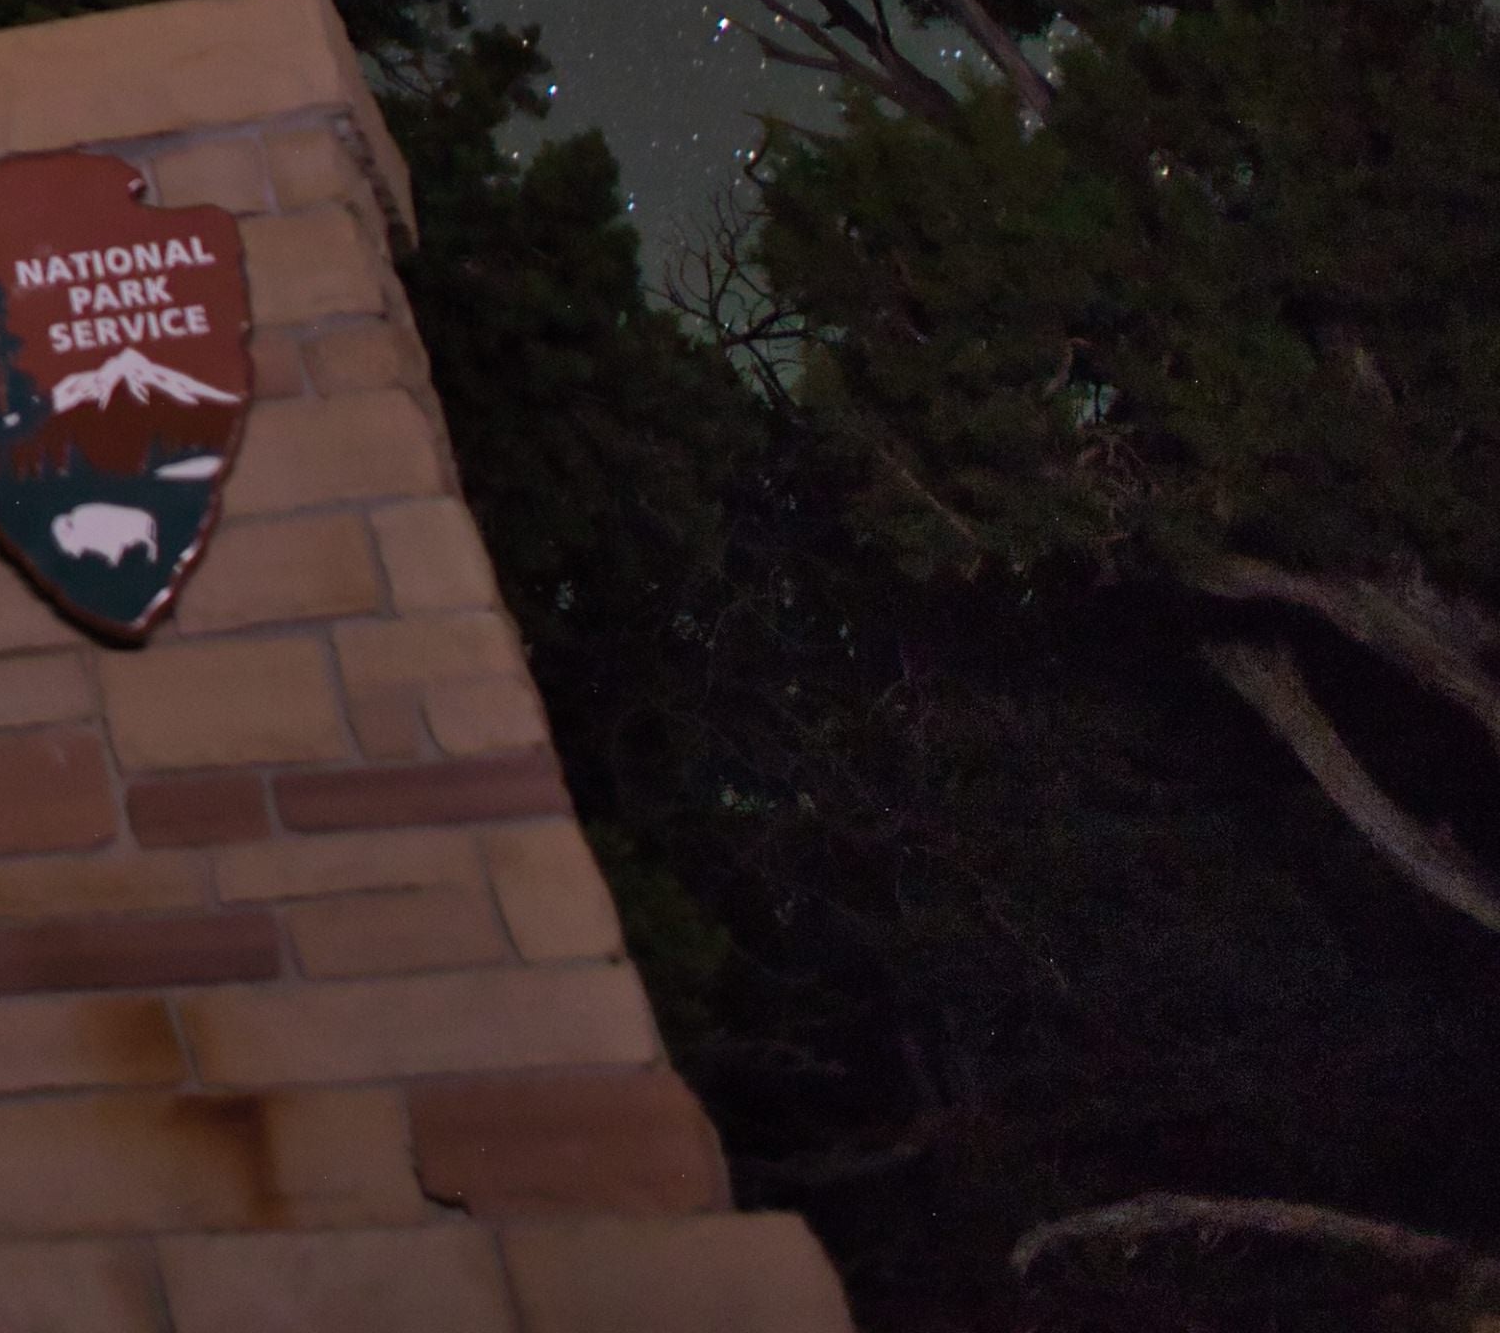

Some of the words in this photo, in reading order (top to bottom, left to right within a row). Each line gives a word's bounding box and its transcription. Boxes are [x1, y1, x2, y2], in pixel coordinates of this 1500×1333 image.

[13, 235, 216, 287] NATIONAL
[67, 275, 173, 315] PARK
[47, 304, 211, 353] SERVICE
